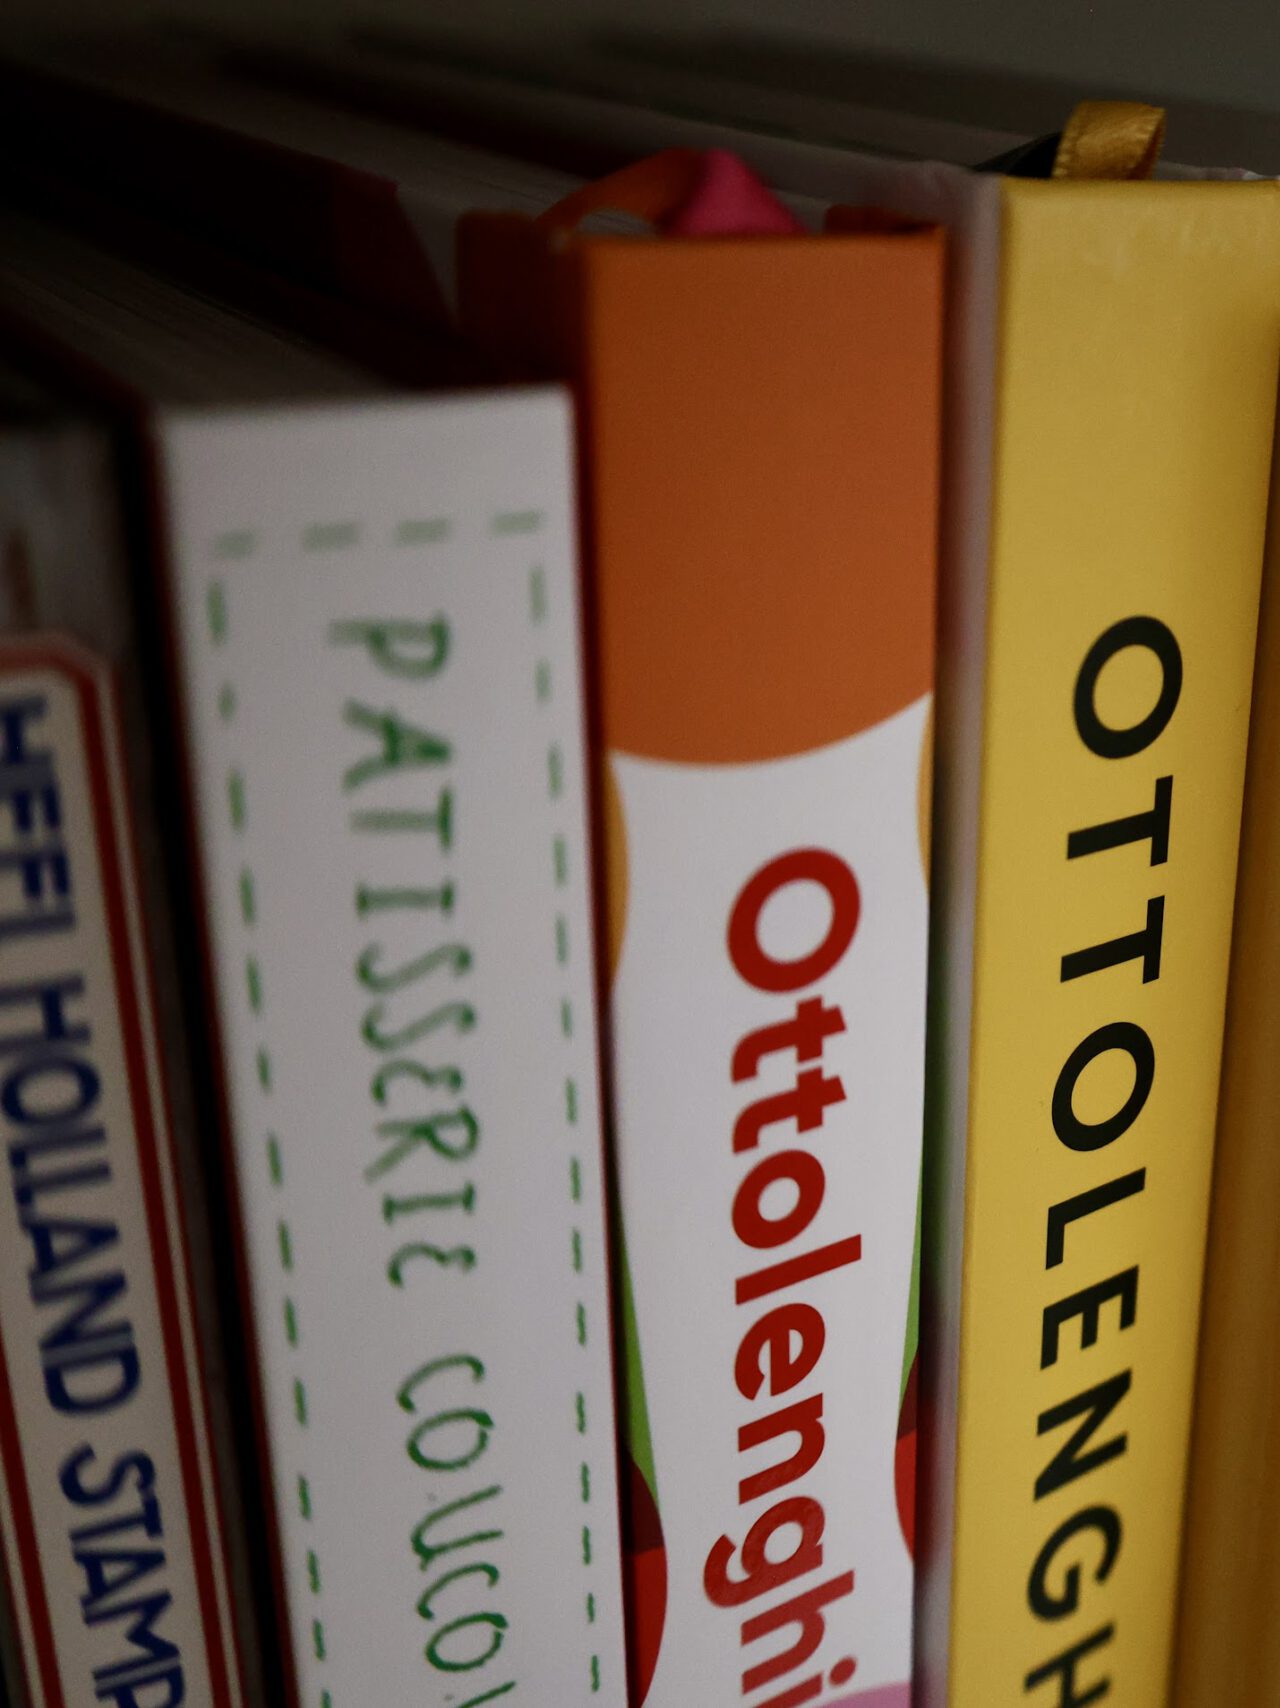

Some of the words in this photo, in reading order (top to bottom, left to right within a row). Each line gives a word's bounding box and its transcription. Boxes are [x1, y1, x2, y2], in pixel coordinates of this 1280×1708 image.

[0, 973, 142, 1417] HOLLAND
[329, 614, 479, 1288] PATISSERIE
[703, 846, 861, 1708] Ottolenghi
[1022, 615, 1183, 1708] OTTOLENGH
[58, 1443, 186, 1708] STAMP
